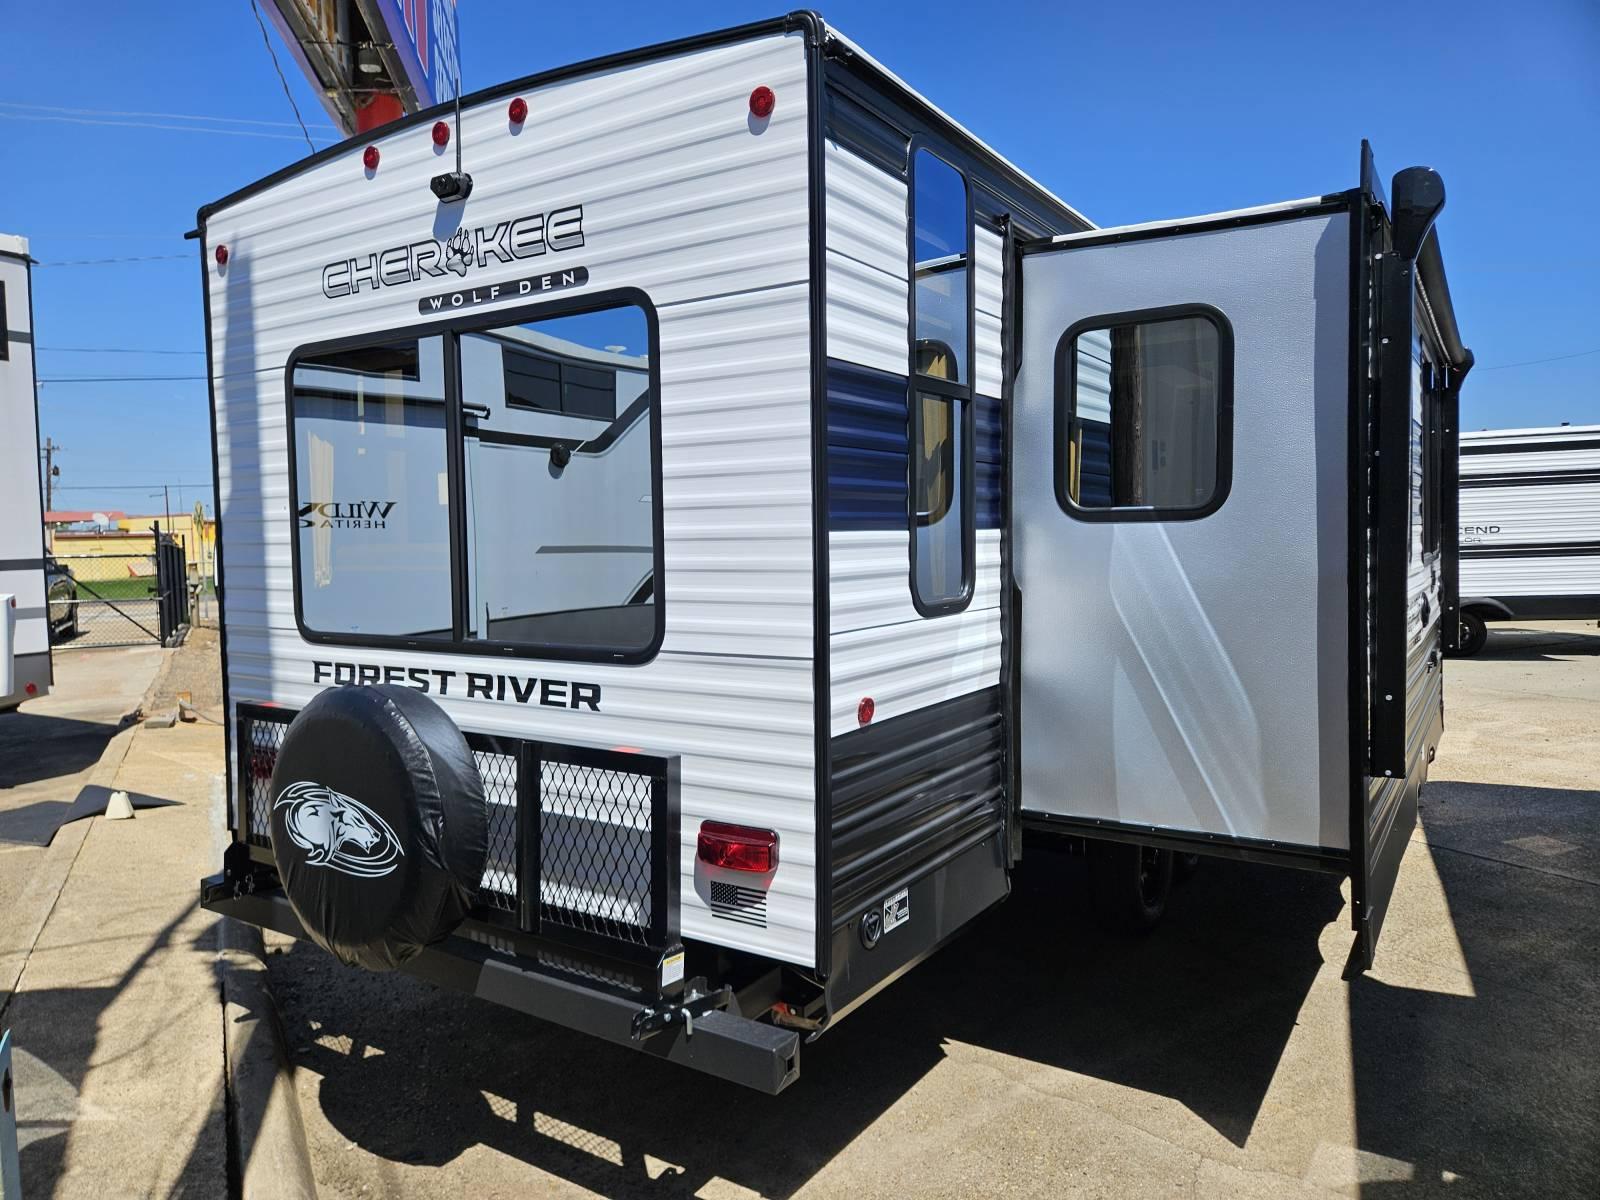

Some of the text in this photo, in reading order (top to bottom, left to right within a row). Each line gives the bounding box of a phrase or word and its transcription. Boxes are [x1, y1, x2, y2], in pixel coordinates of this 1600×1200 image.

[429, 271, 576, 311] WOLF DEN
[312, 660, 601, 712] FOREST RIVER
